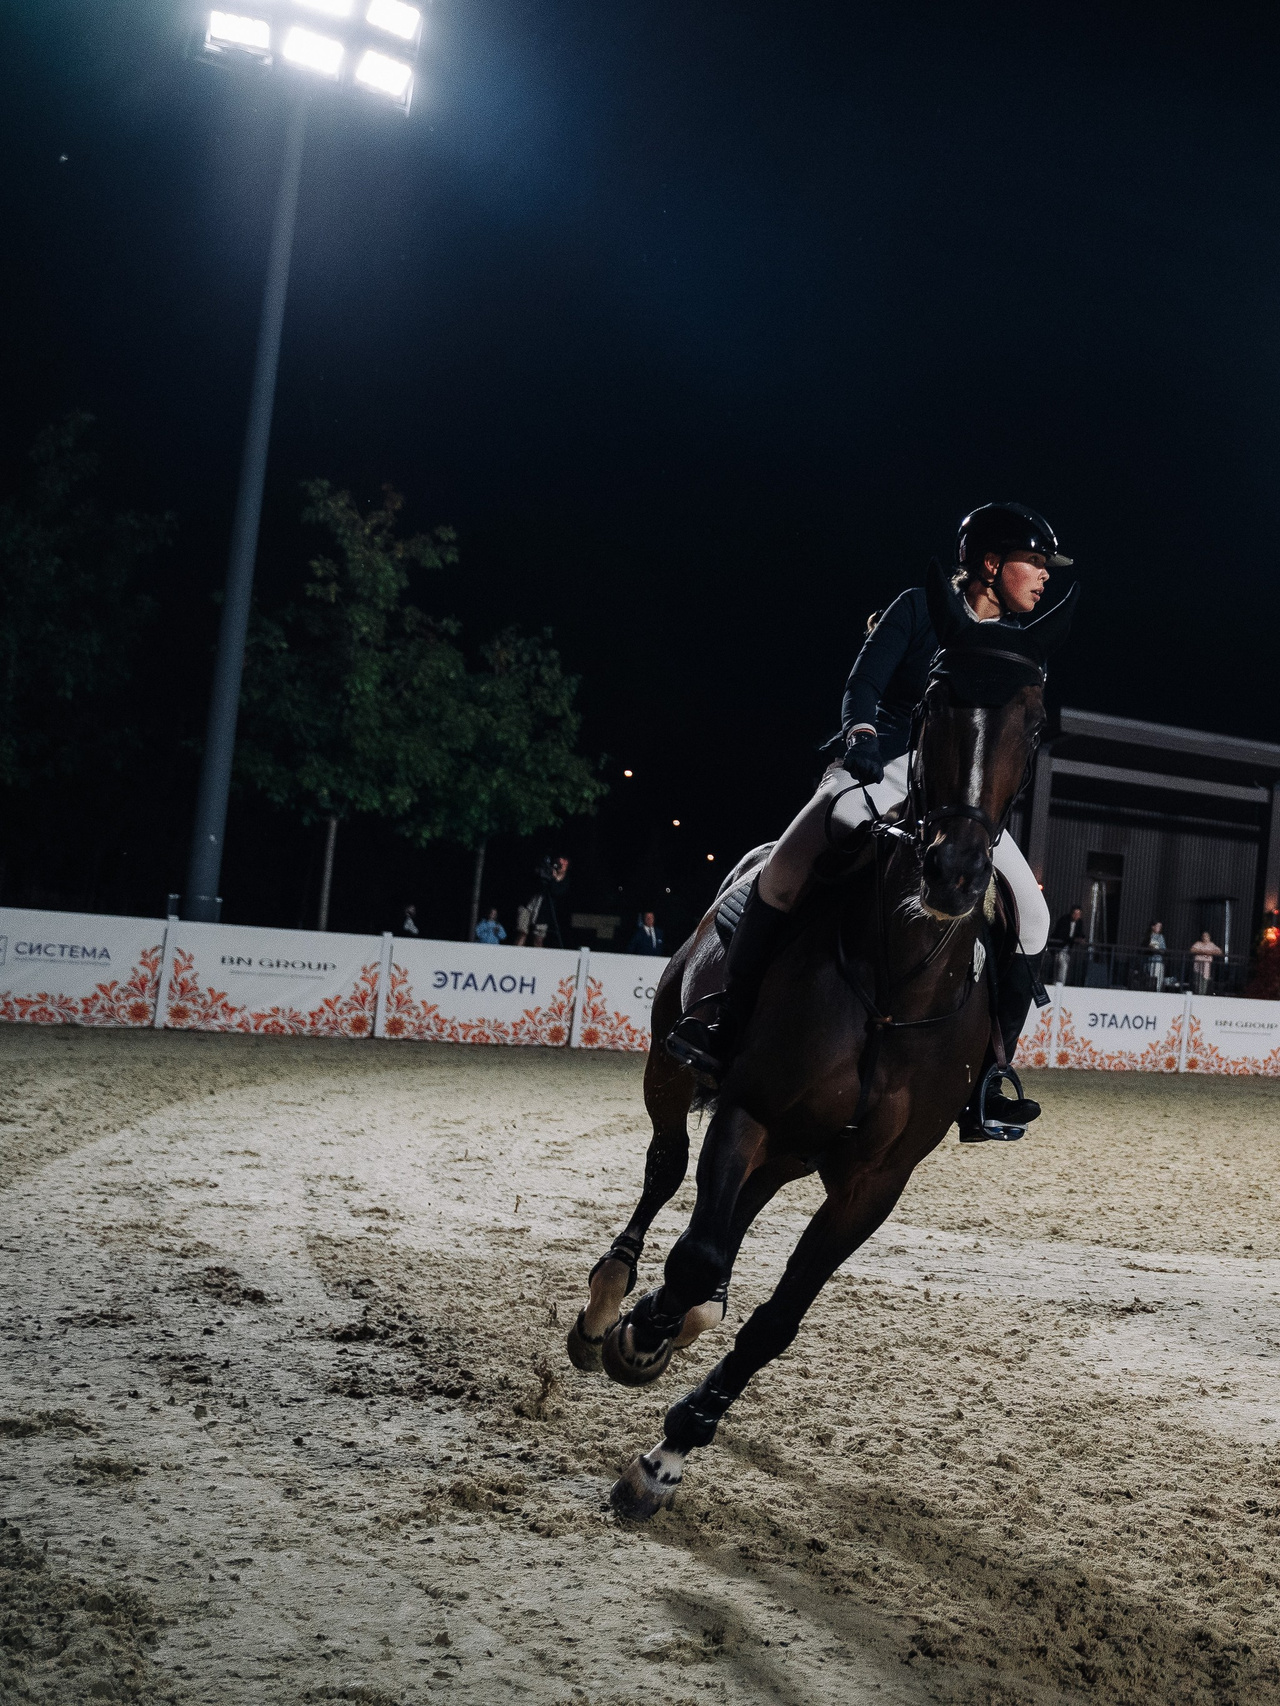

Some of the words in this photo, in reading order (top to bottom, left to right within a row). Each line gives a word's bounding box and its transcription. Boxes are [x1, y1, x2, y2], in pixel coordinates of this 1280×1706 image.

[14, 941, 111, 960] СИСТЕМА
[259, 957, 337, 971] GROUP
[433, 970, 536, 994] ЭТАЛОН
[1088, 1012, 1156, 1030] ЭТАЛОН
